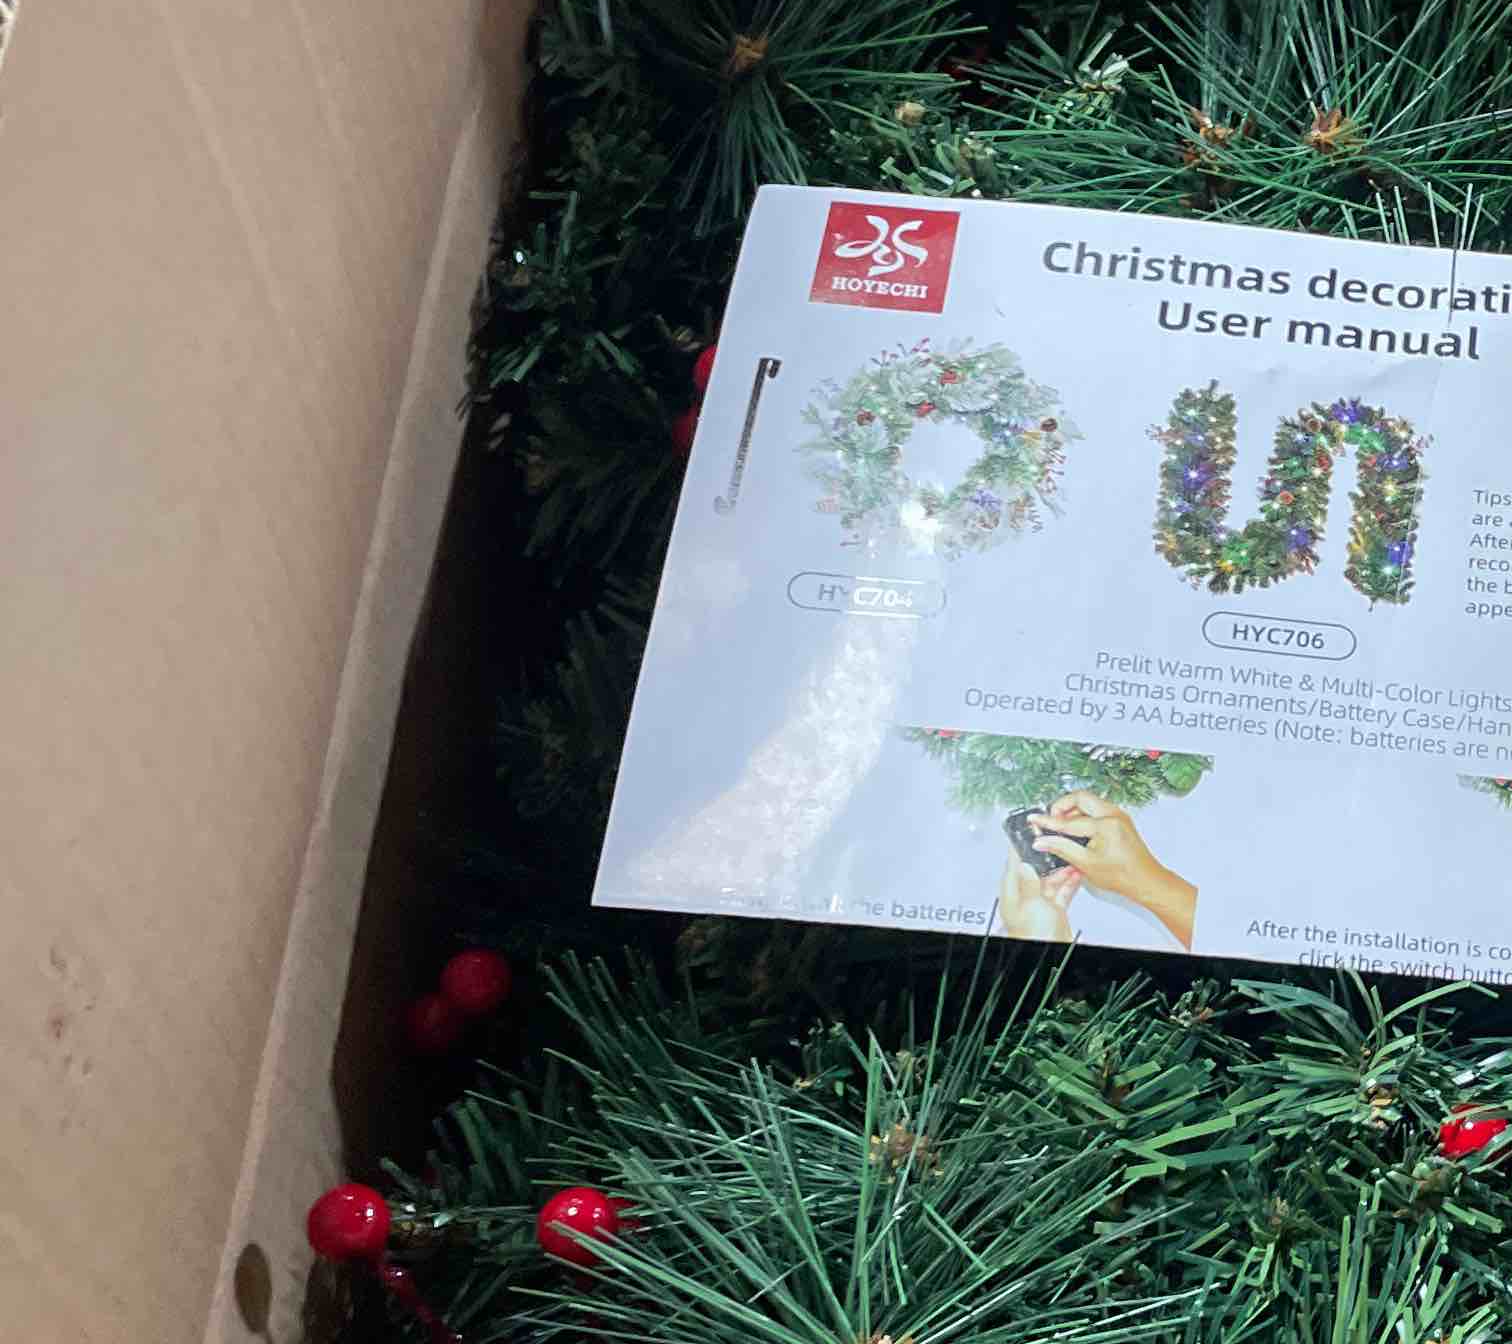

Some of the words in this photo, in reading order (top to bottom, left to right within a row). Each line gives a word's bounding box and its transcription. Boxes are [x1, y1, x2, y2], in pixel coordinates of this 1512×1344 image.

[1042, 239, 1291, 295] Christmas
[831, 276, 929, 299] HOYECHI
[1157, 300, 1272, 340] User
[1286, 319, 1481, 360] manual
[1472, 514, 1503, 527] are
[1467, 577, 1498, 593] the
[1231, 622, 1325, 649] HYC706
[1065, 672, 1175, 701] Christmas
[1096, 652, 1151, 674] Prelit
[1159, 657, 1223, 681] Warm
[1231, 665, 1293, 689] White
[1299, 674, 1314, 692] &
[1322, 676, 1443, 705] Multi-Color
[965, 688, 1073, 715] Operated
[1080, 698, 1106, 721] by
[1170, 707, 1266, 736] batteries
[1273, 718, 1344, 745] (Note:
[1350, 726, 1446, 755] batteries
[1453, 742, 1488, 759] are
[890, 901, 987, 926] batteries
[1247, 919, 1298, 941] After
[1304, 926, 1337, 944] the
[1344, 928, 1459, 957] installation
[1467, 941, 1481, 958] is
[1300, 949, 1343, 968] click
[1351, 955, 1383, 972] the
[1391, 960, 1454, 978] switch
